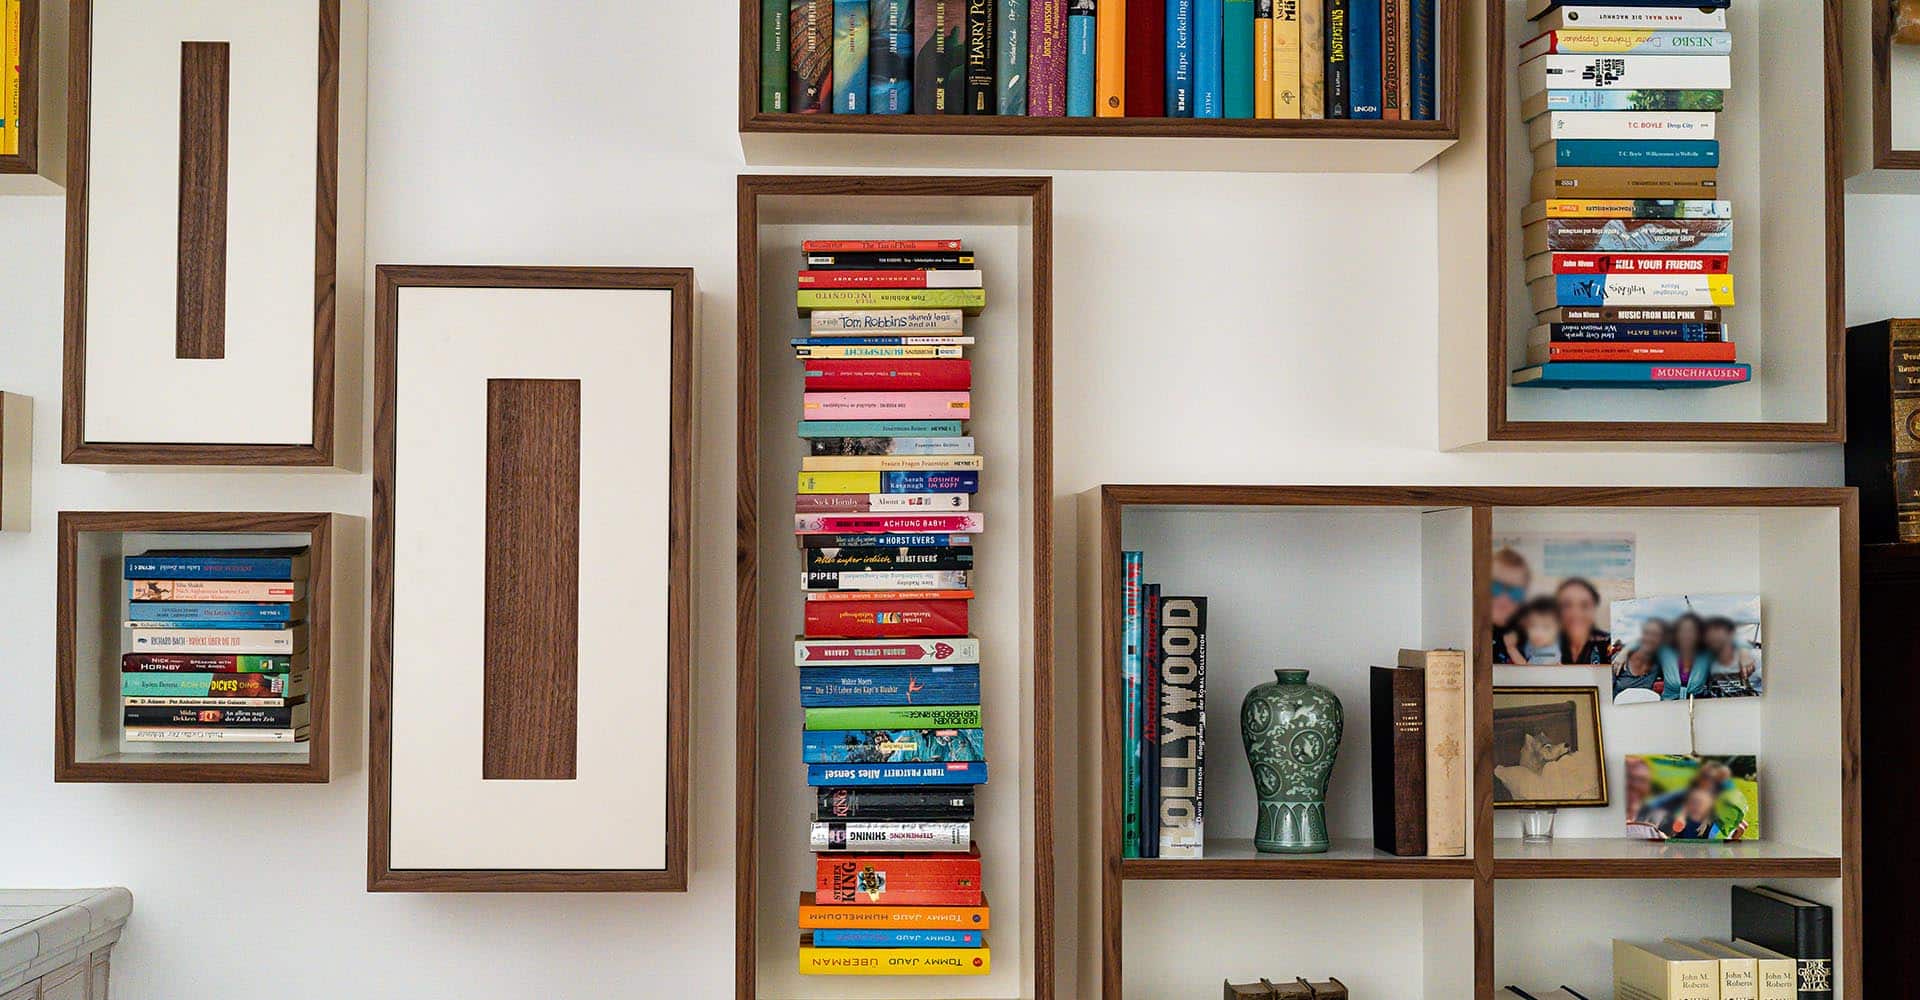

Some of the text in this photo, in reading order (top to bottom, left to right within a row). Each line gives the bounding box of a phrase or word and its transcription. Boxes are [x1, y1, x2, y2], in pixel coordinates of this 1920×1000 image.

[889, 2, 898, 53] JOANNE ROWLING
[936, 2, 944, 53] JOANNE ROWLING
[1042, 1, 1052, 58] Jonas Jonasson
[970, 20, 984, 65] HARRY
[1176, 0, 1189, 80] Hape Kerkeling
[1672, 36, 1713, 48] NESBØ
[1616, 260, 1636, 269] KILL
[1637, 260, 1662, 269] YOUR
[1665, 260, 1704, 270] FRIENDS
[1618, 310, 1641, 320] MUSIC
[1642, 310, 1662, 320] FROM
[1662, 310, 1674, 320] BIG
[1675, 310, 1695, 320] PINK
[838, 314, 908, 329] Tom Robbins
[1658, 366, 1740, 378] MÜNCHHAUSEN
[832, 498, 858, 506] Hornby
[922, 520, 946, 528] BABY!
[886, 536, 910, 544] HORST
[912, 536, 936, 544] EVERS
[896, 555, 938, 563] HORST EVERS
[810, 572, 838, 580] PIPER
[150, 636, 171, 645] RICHARD
[211, 680, 238, 692] DICKES
[1160, 600, 1198, 856] HOLLYWOOD
[825, 769, 945, 780] TERRY PRATCHETT Alles Sense!
[850, 832, 886, 841] SHINING
[842, 862, 857, 902] KING
[812, 958, 878, 968] ÜBERMAN
[1725, 972, 1741, 980] John
